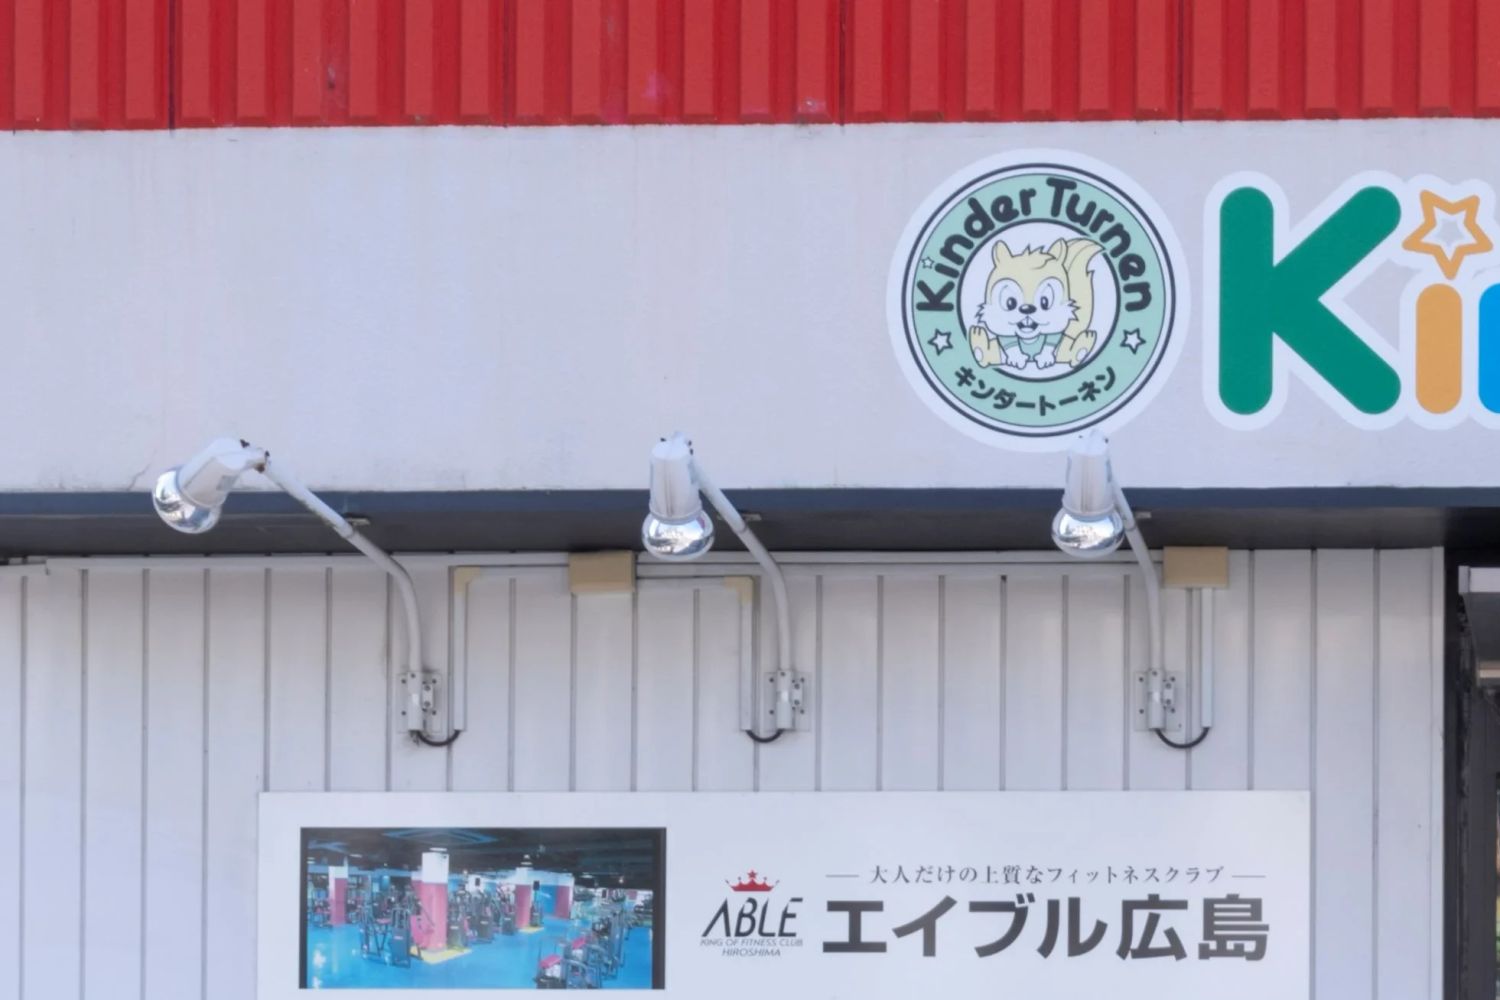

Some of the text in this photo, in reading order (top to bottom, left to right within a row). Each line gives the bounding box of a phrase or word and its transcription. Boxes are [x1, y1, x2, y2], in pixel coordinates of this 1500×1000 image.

[916, 177, 1152, 312] Kinder Turnen
[954, 366, 1116, 416] キンダートーネン
[868, 864, 1226, 886] 大人だけの上質なフィットネスクラブ
[701, 897, 803, 937] ABLE
[822, 892, 1270, 962] エイブル広島
[700, 938, 804, 948] KING OF FITNESS CLUB
[722, 948, 782, 957] HIROSHIMA
